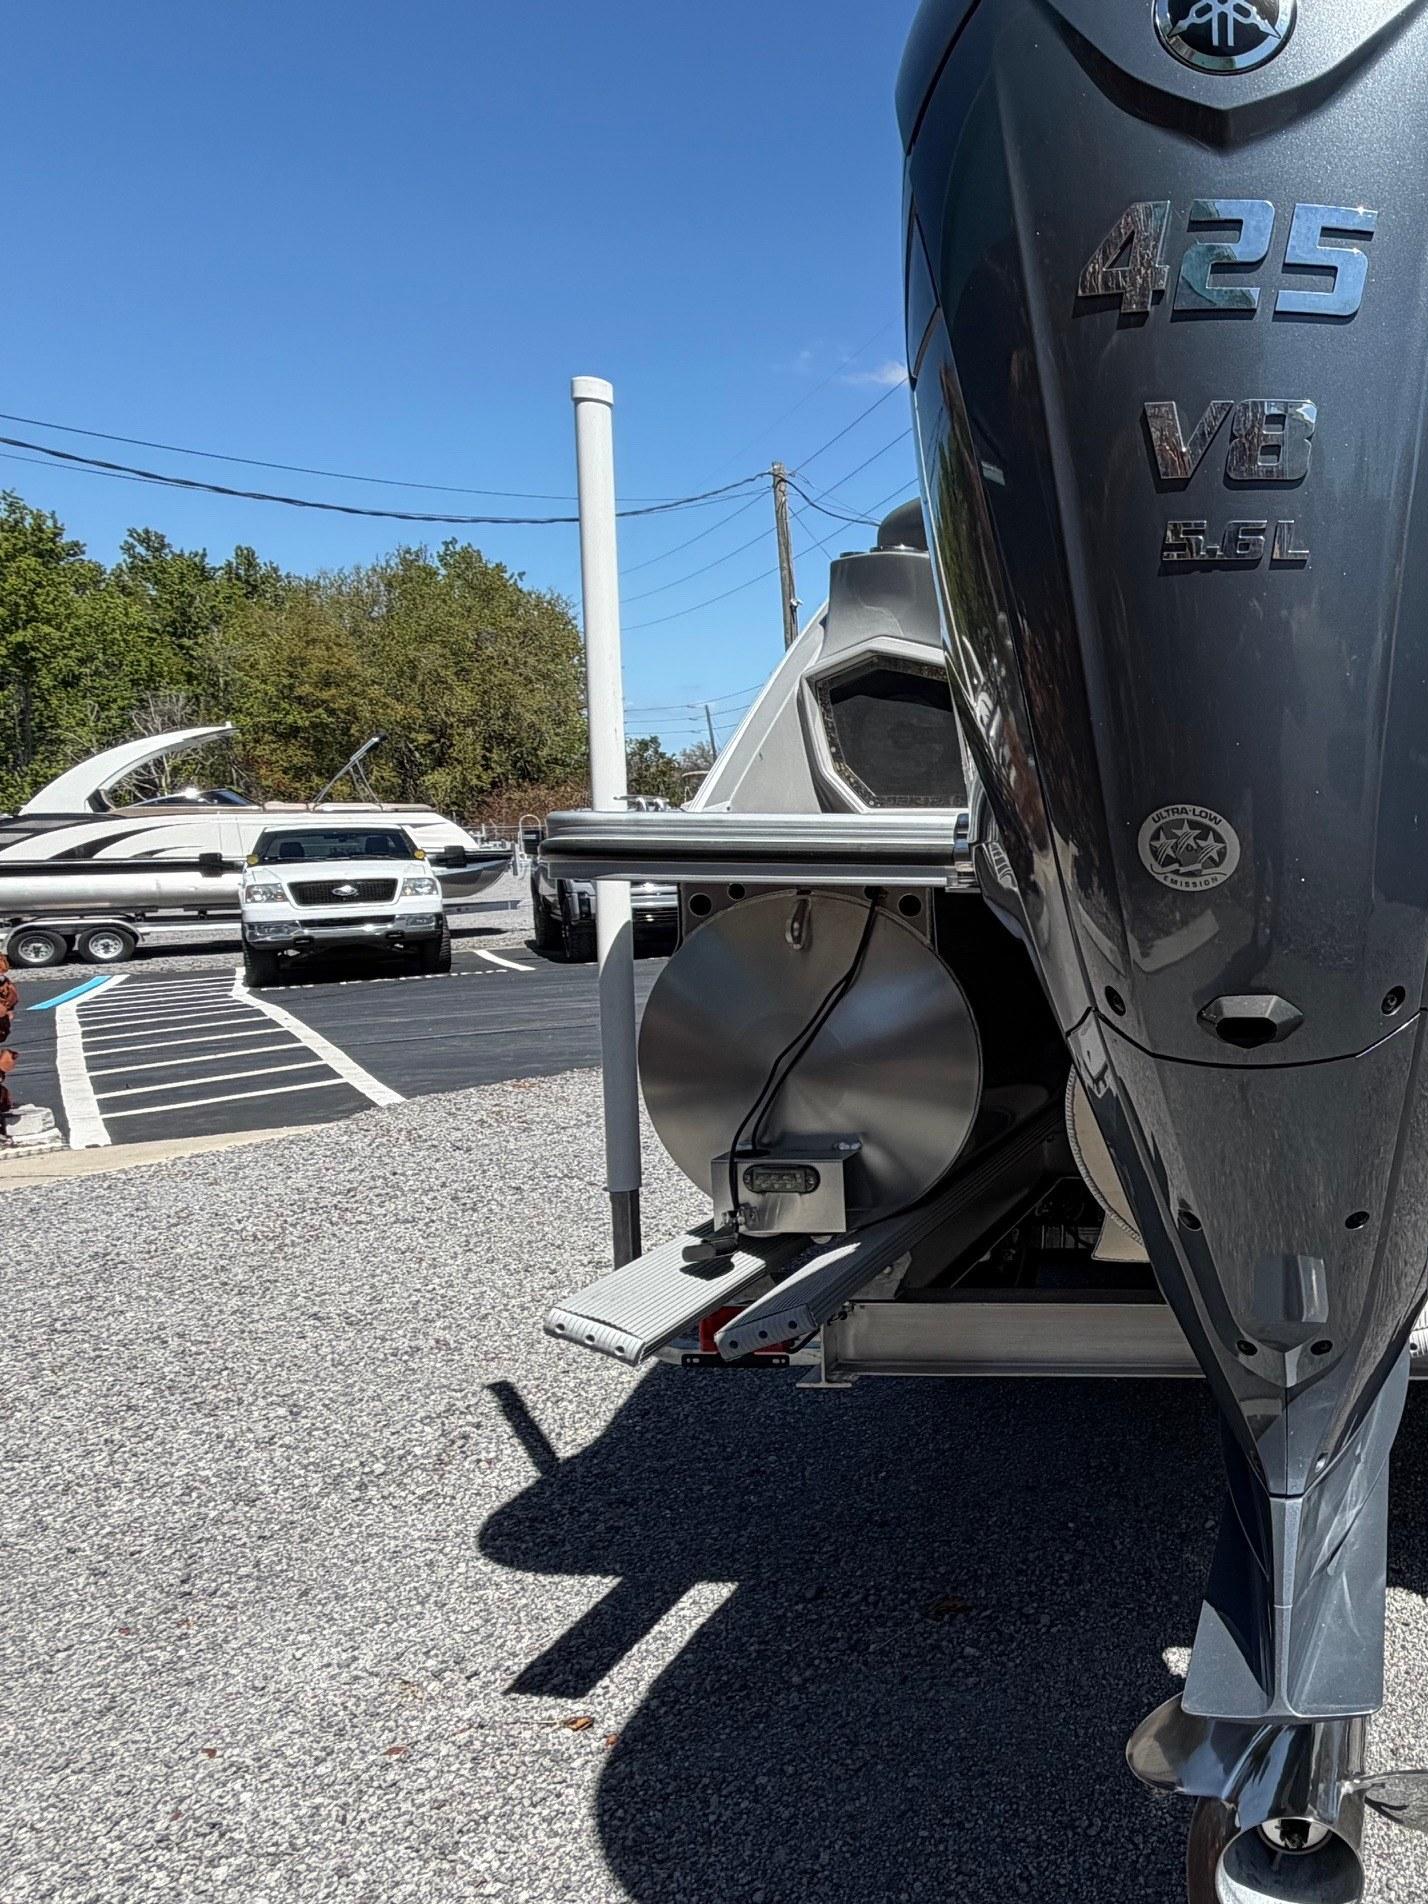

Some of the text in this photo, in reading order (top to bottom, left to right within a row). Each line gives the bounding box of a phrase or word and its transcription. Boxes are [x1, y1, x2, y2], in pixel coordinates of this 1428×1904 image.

[1077, 198, 1379, 316] 425
[1143, 399, 1318, 481] V8
[1161, 519, 1310, 561] 5.6L
[1163, 875, 1219, 888] EMISSION
